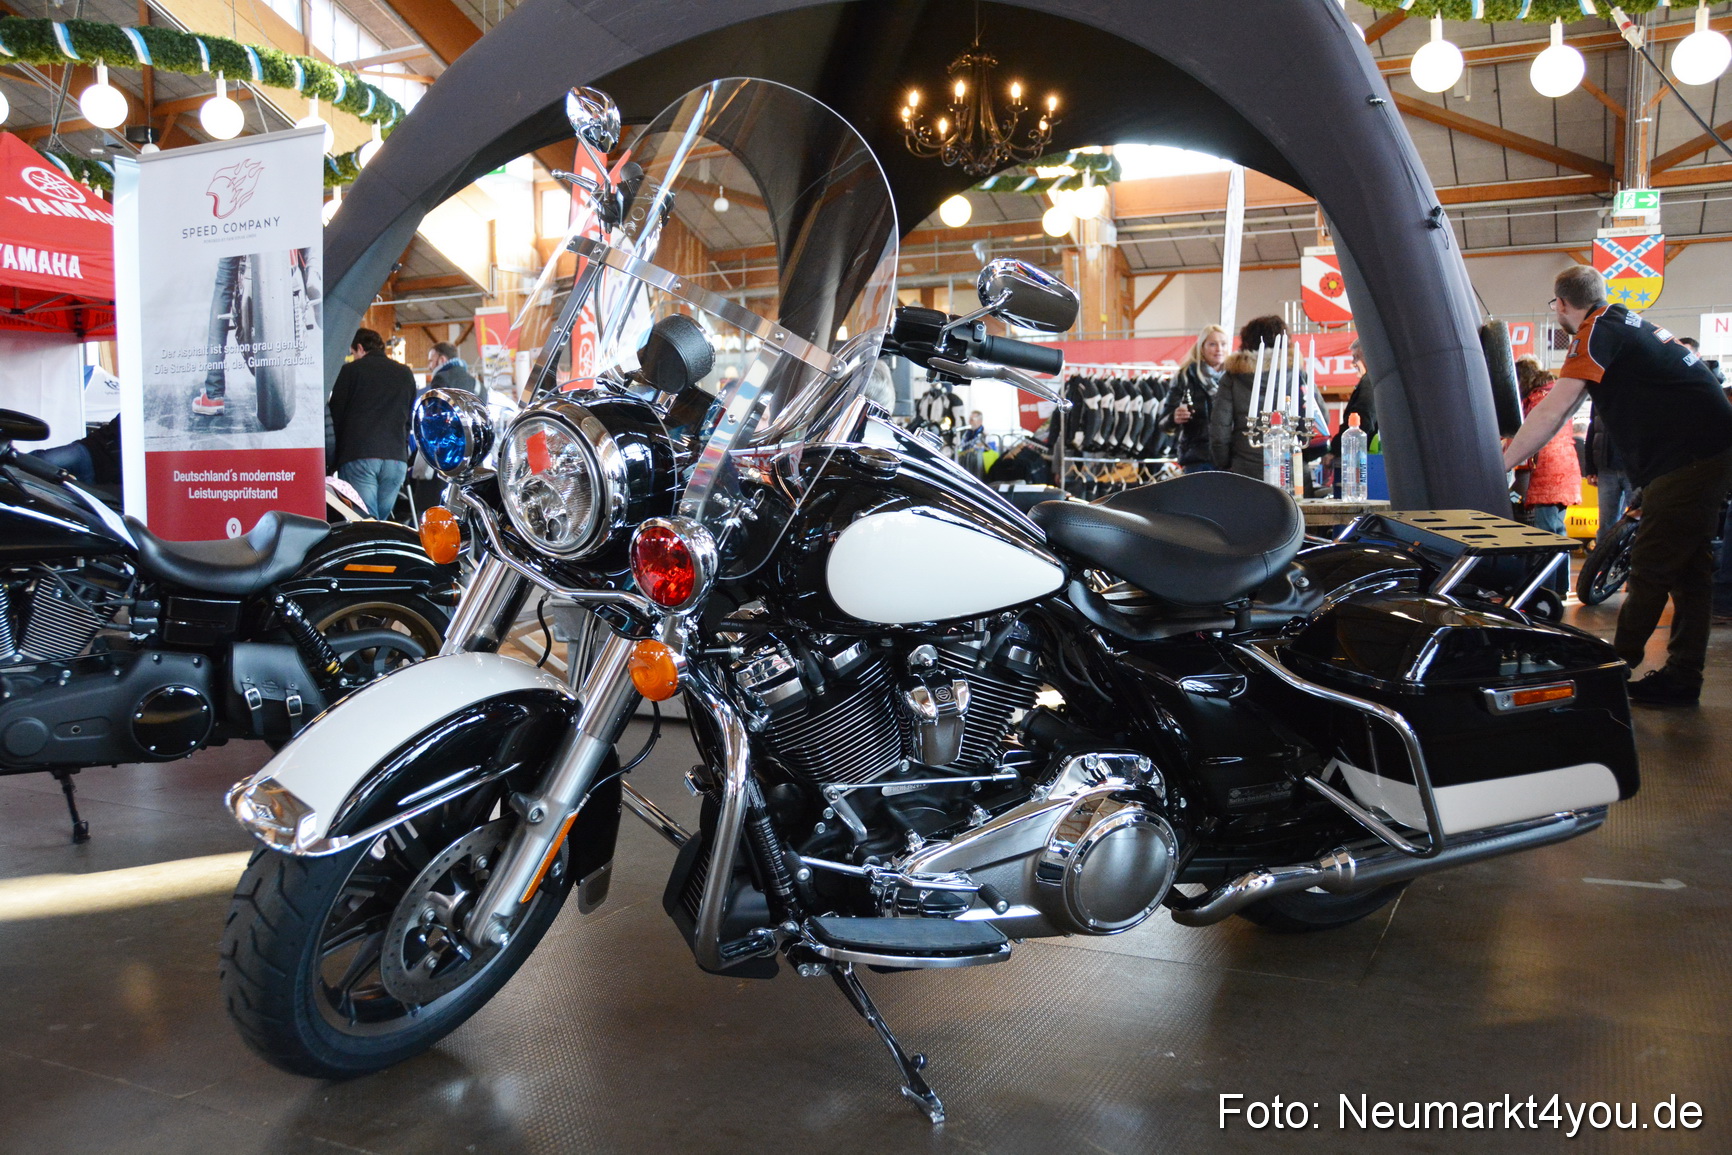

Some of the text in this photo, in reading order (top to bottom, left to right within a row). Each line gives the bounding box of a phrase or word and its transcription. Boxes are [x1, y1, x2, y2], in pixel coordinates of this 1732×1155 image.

[5, 195, 114, 226] YAMAH
[182, 225, 218, 239] SPEED
[223, 216, 281, 234] COMPANY
[161, 349, 176, 359] Der
[178, 346, 209, 359] Asphalt
[210, 344, 223, 355] ist
[224, 342, 251, 354] schon
[253, 341, 273, 353] grau
[154, 364, 169, 375] Die
[171, 362, 196, 373] Straße
[232, 358, 246, 369] der
[249, 356, 281, 368] Gummi
[240, 469, 296, 481] modernster
[188, 486, 278, 502] Leistungsprüfstand
